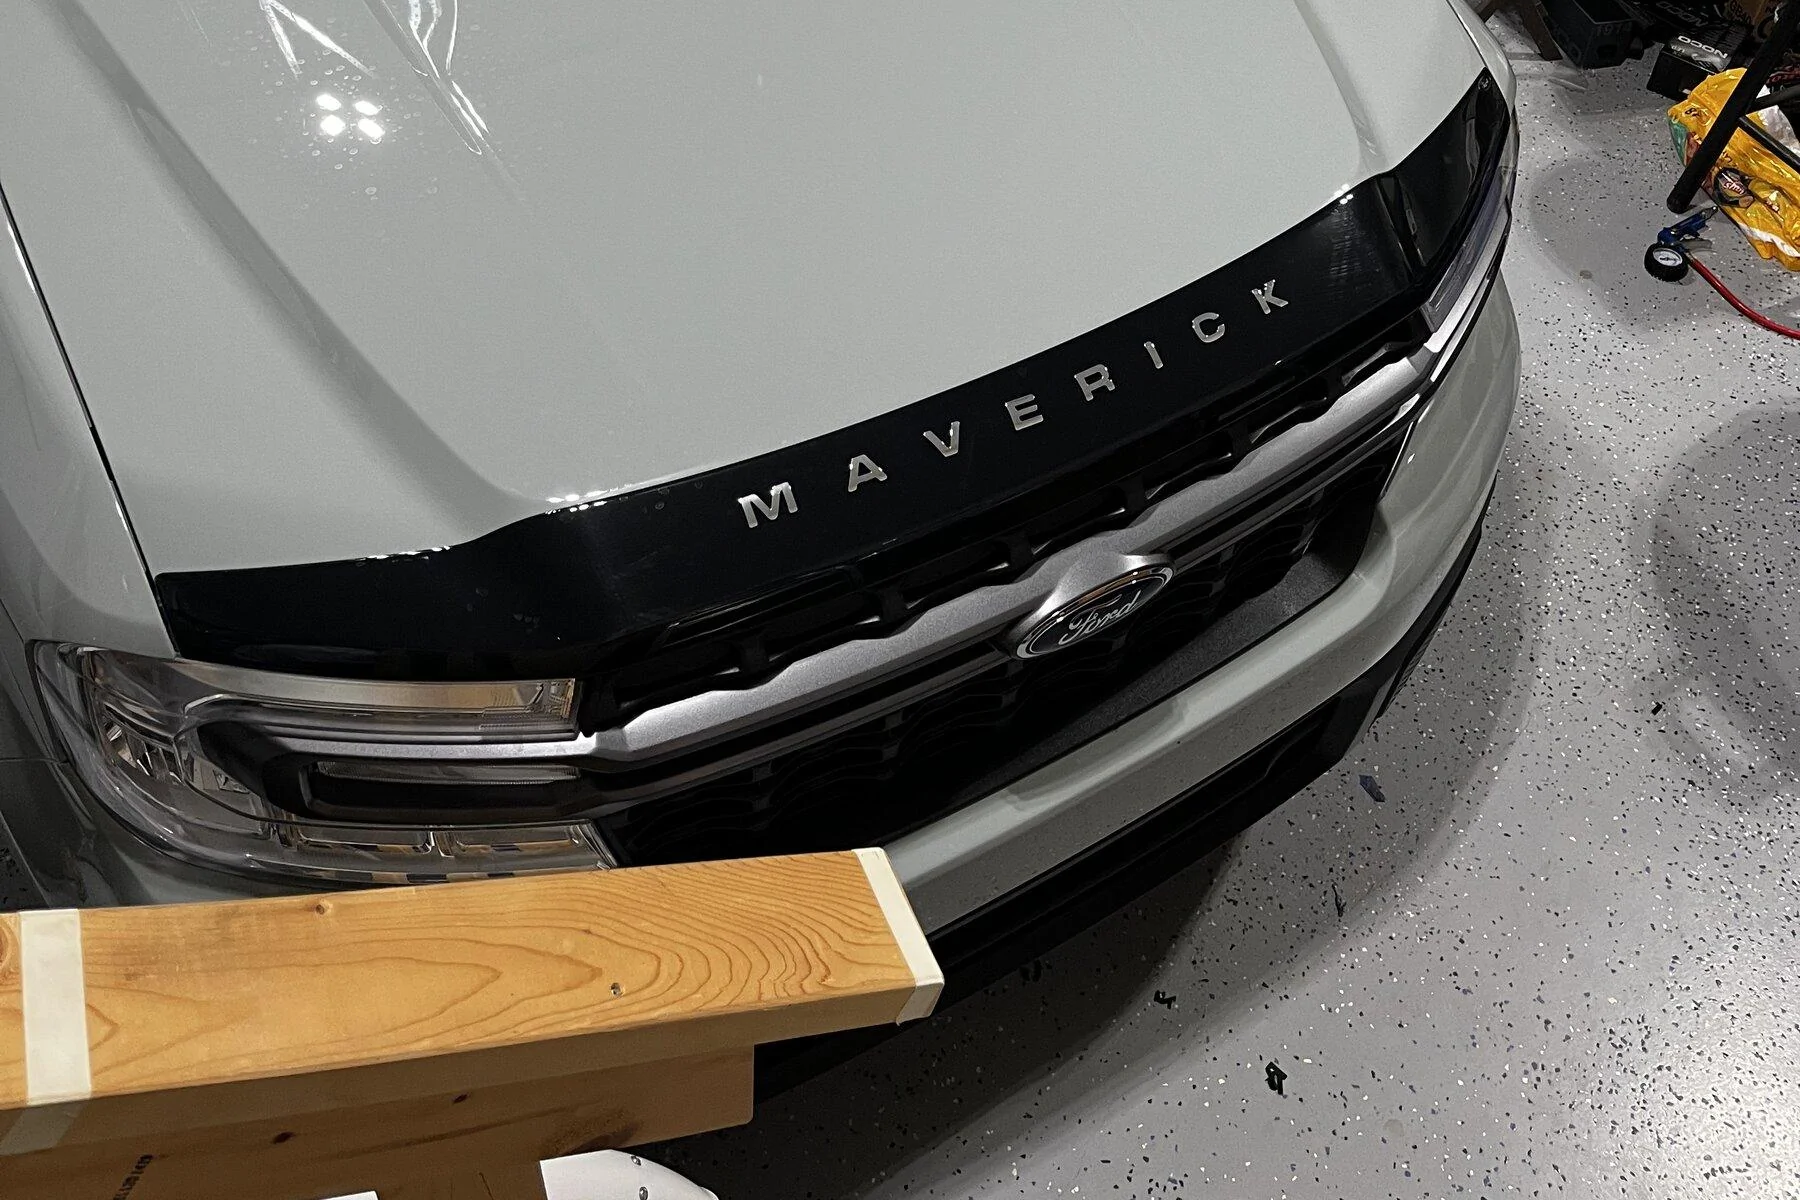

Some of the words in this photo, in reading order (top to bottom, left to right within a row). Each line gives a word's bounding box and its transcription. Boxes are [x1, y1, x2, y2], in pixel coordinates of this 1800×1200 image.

[1656, 1, 1708, 27] NOCO
[1677, 35, 1728, 59] NOCO
[738, 278, 1289, 528] MAVERICK
[1058, 589, 1142, 645] Ford
